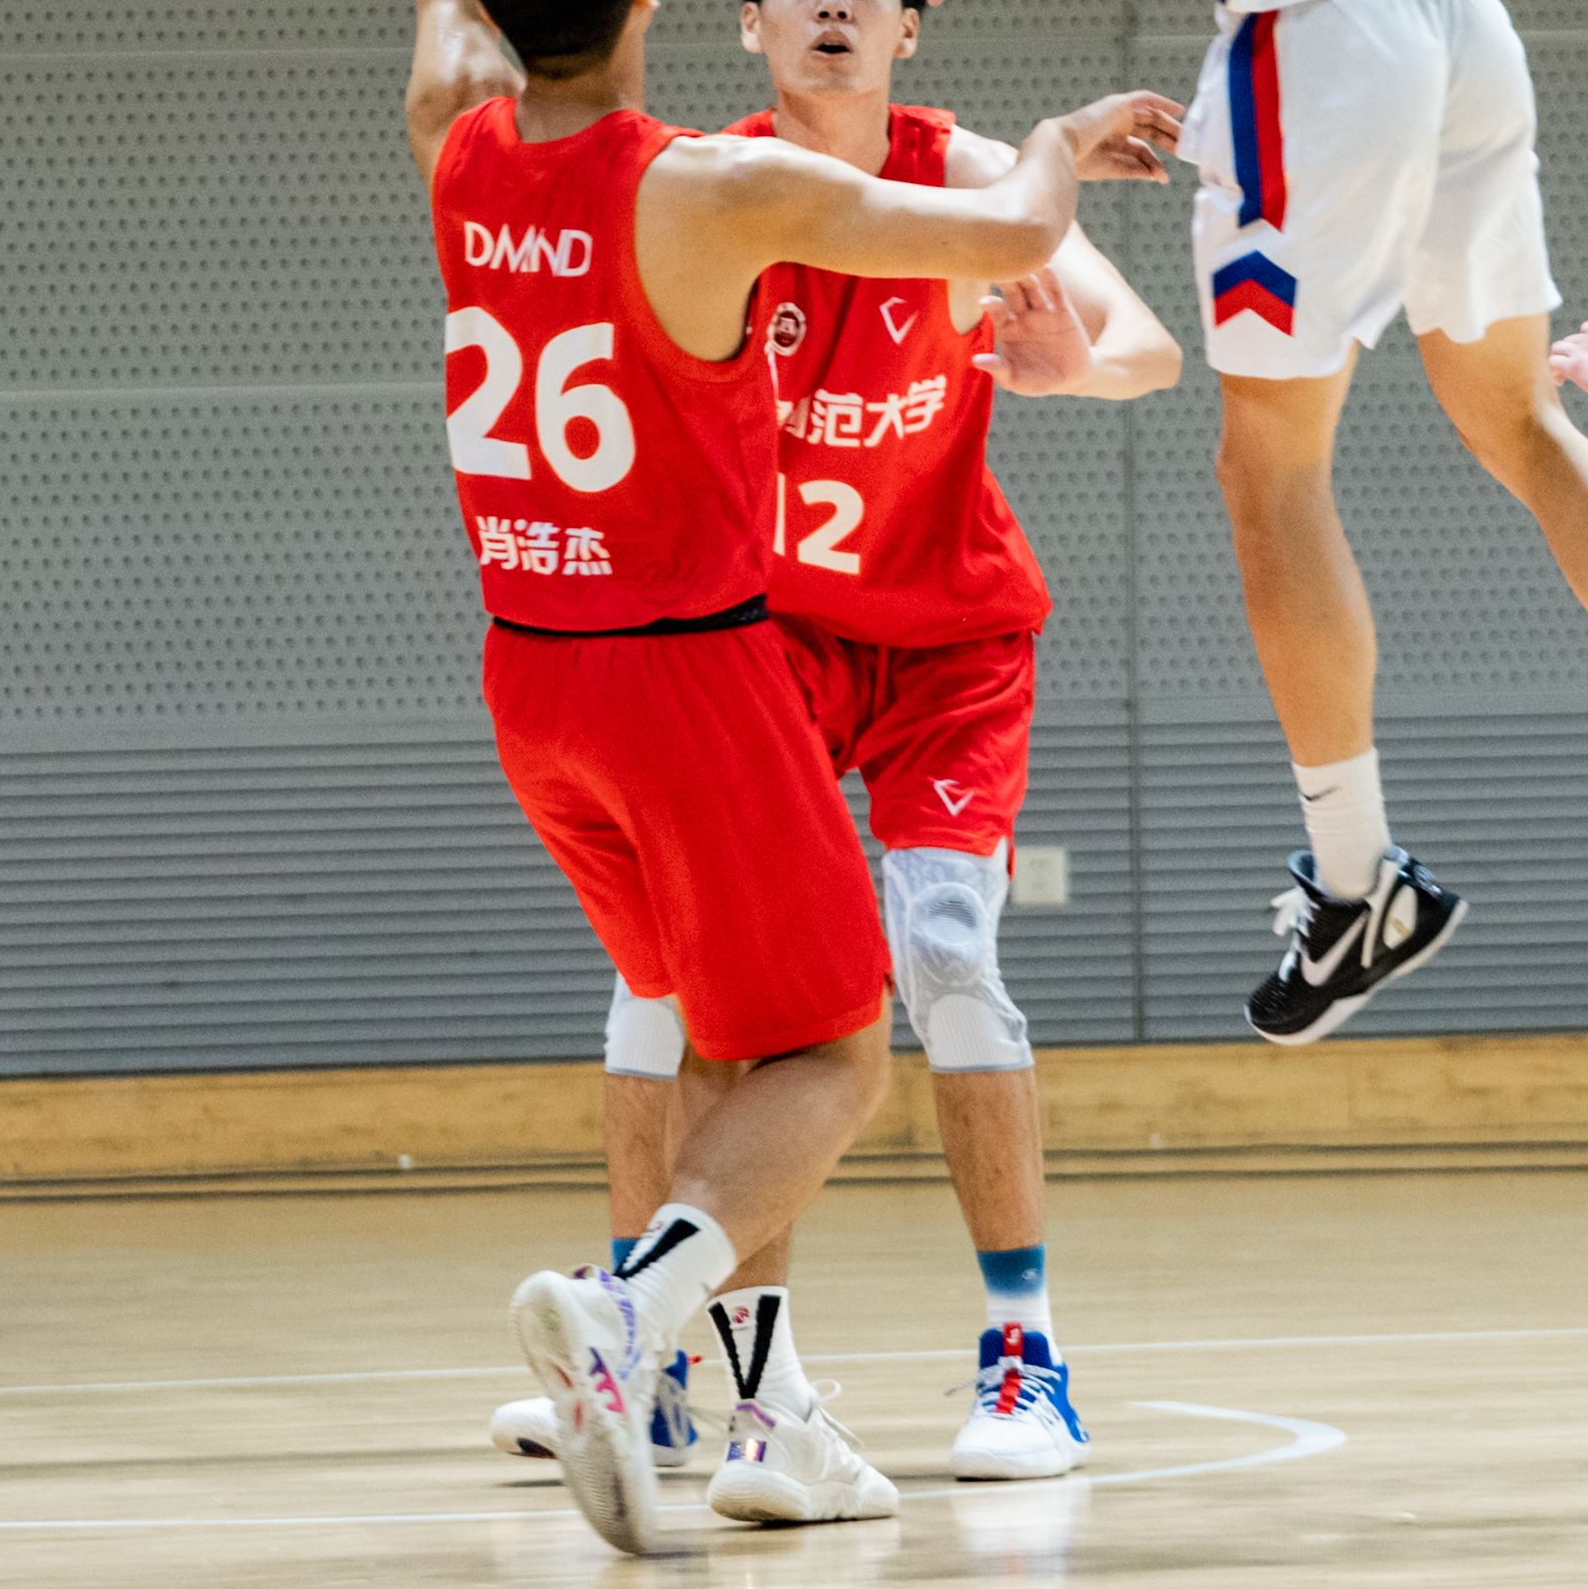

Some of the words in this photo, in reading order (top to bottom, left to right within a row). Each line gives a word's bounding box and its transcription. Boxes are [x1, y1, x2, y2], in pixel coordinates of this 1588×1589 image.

[445, 305, 635, 493] 26
[475, 516, 613, 575] 肖浩杰
